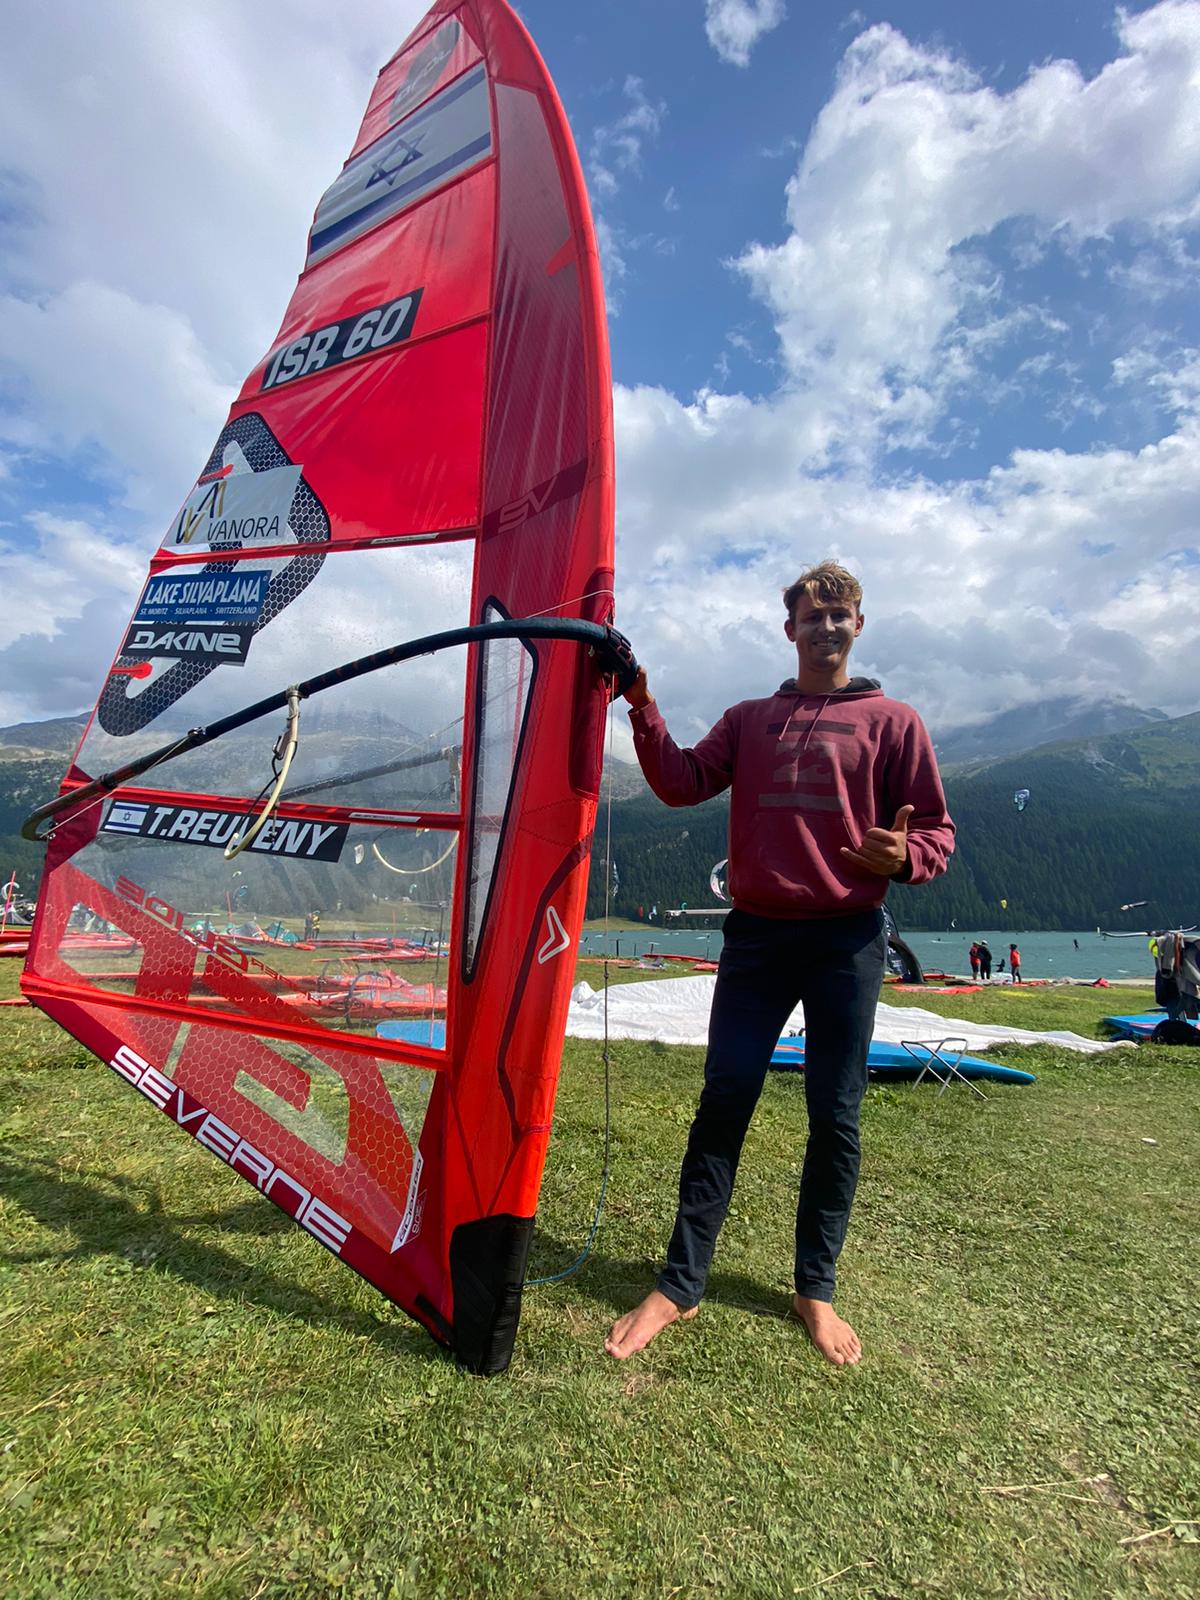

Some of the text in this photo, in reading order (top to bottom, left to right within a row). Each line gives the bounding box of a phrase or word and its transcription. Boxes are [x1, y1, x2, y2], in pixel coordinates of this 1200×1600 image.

[264, 296, 412, 389] ISR 60
[207, 515, 279, 541] VANORA
[144, 576, 262, 605] LAKE SILVAPLANA
[174, 607, 207, 615] SILVAPLANA
[214, 606, 258, 615] SWITZERLAND
[110, 1045, 353, 1254] SEVERNE
